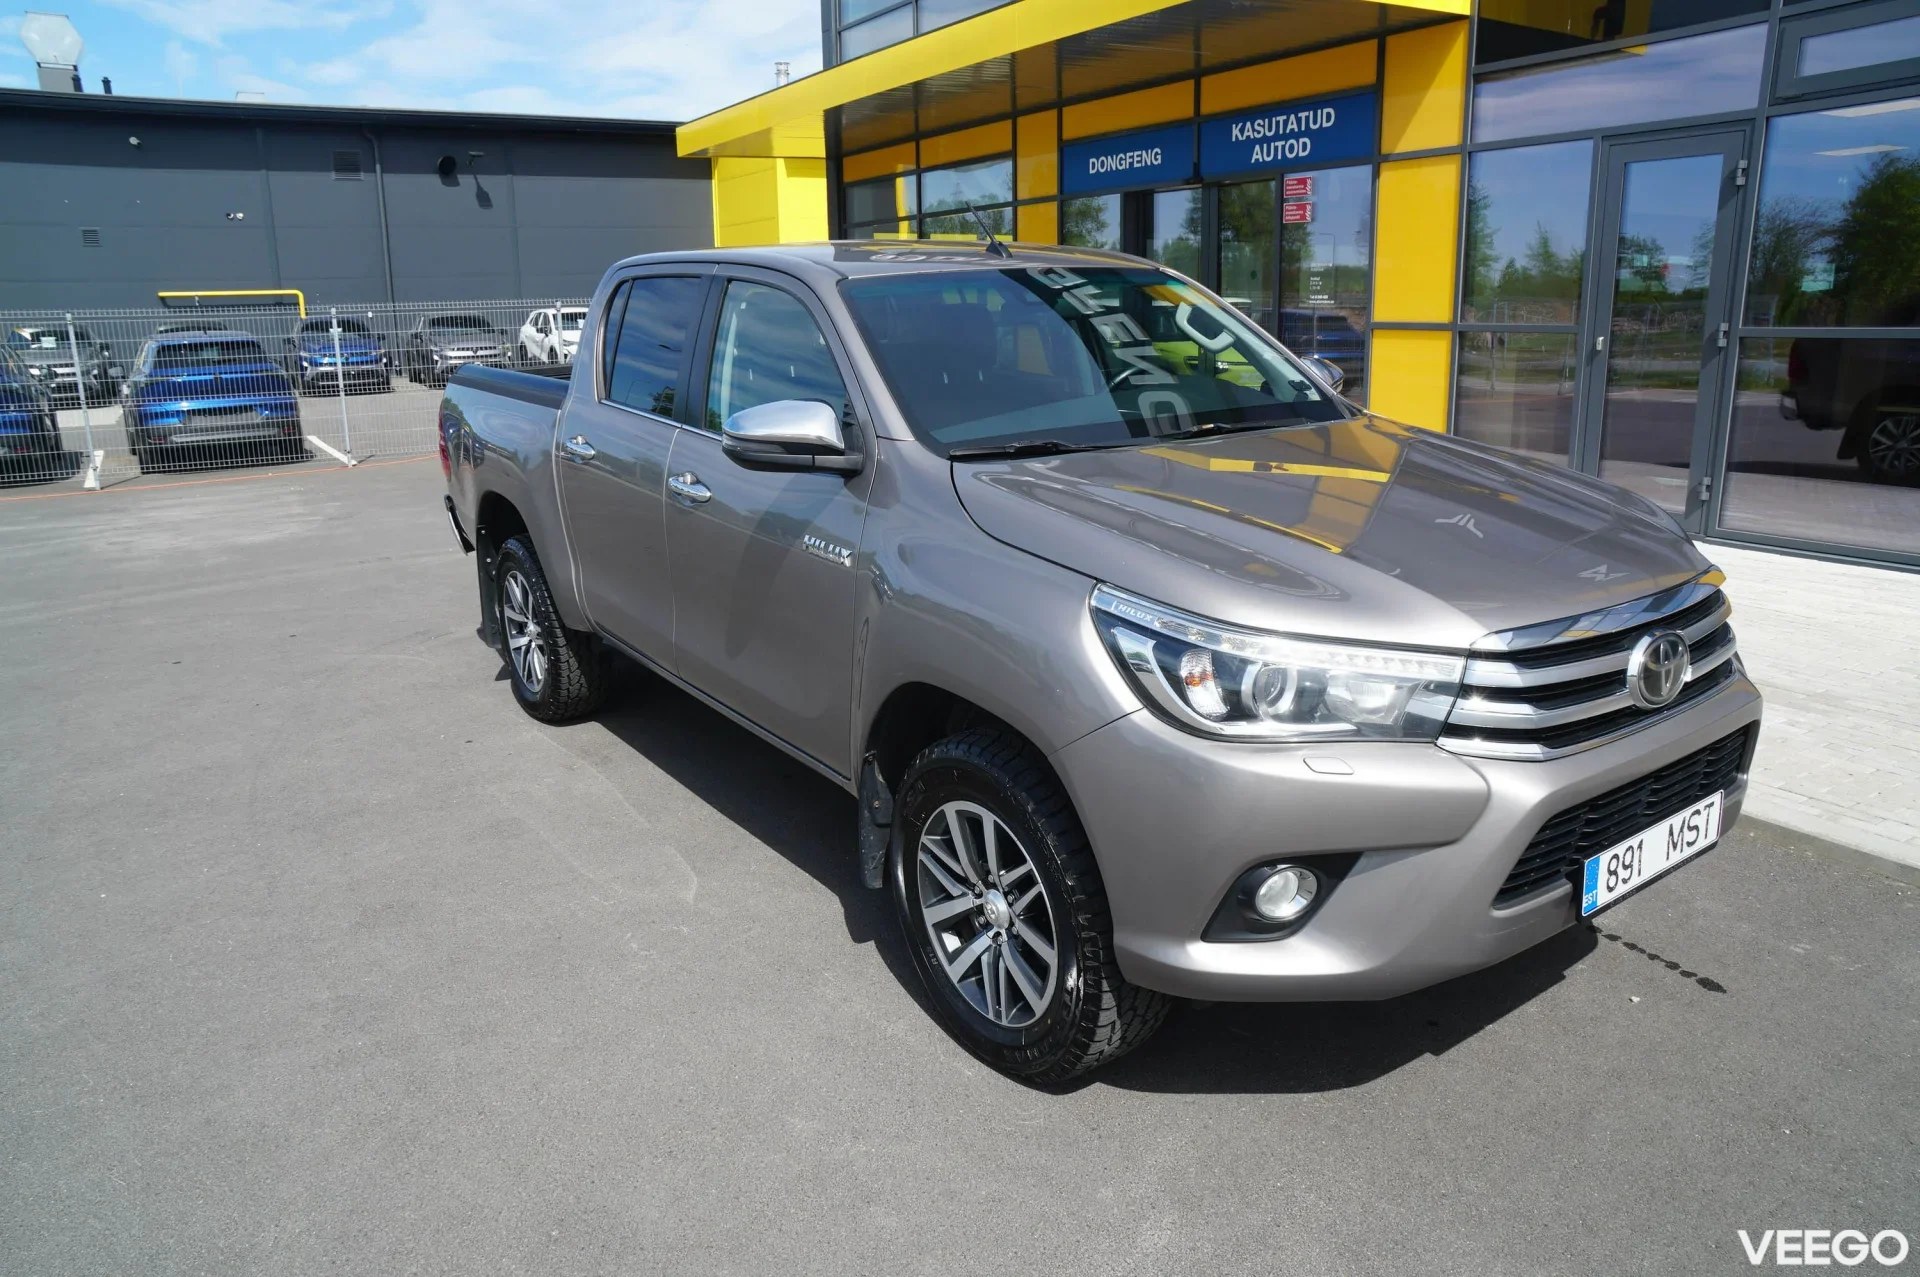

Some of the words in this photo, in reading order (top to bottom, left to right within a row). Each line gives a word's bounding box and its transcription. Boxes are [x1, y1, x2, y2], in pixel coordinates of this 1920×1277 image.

[1231, 107, 1336, 142] KASUTATUD
[1089, 147, 1162, 174] DONGFENG
[1251, 137, 1311, 164] AUTOD
[1118, 604, 1153, 622] HILUX
[1606, 838, 1644, 893] 891
[1666, 801, 1715, 861] MST
[1584, 890, 1597, 907] EST
